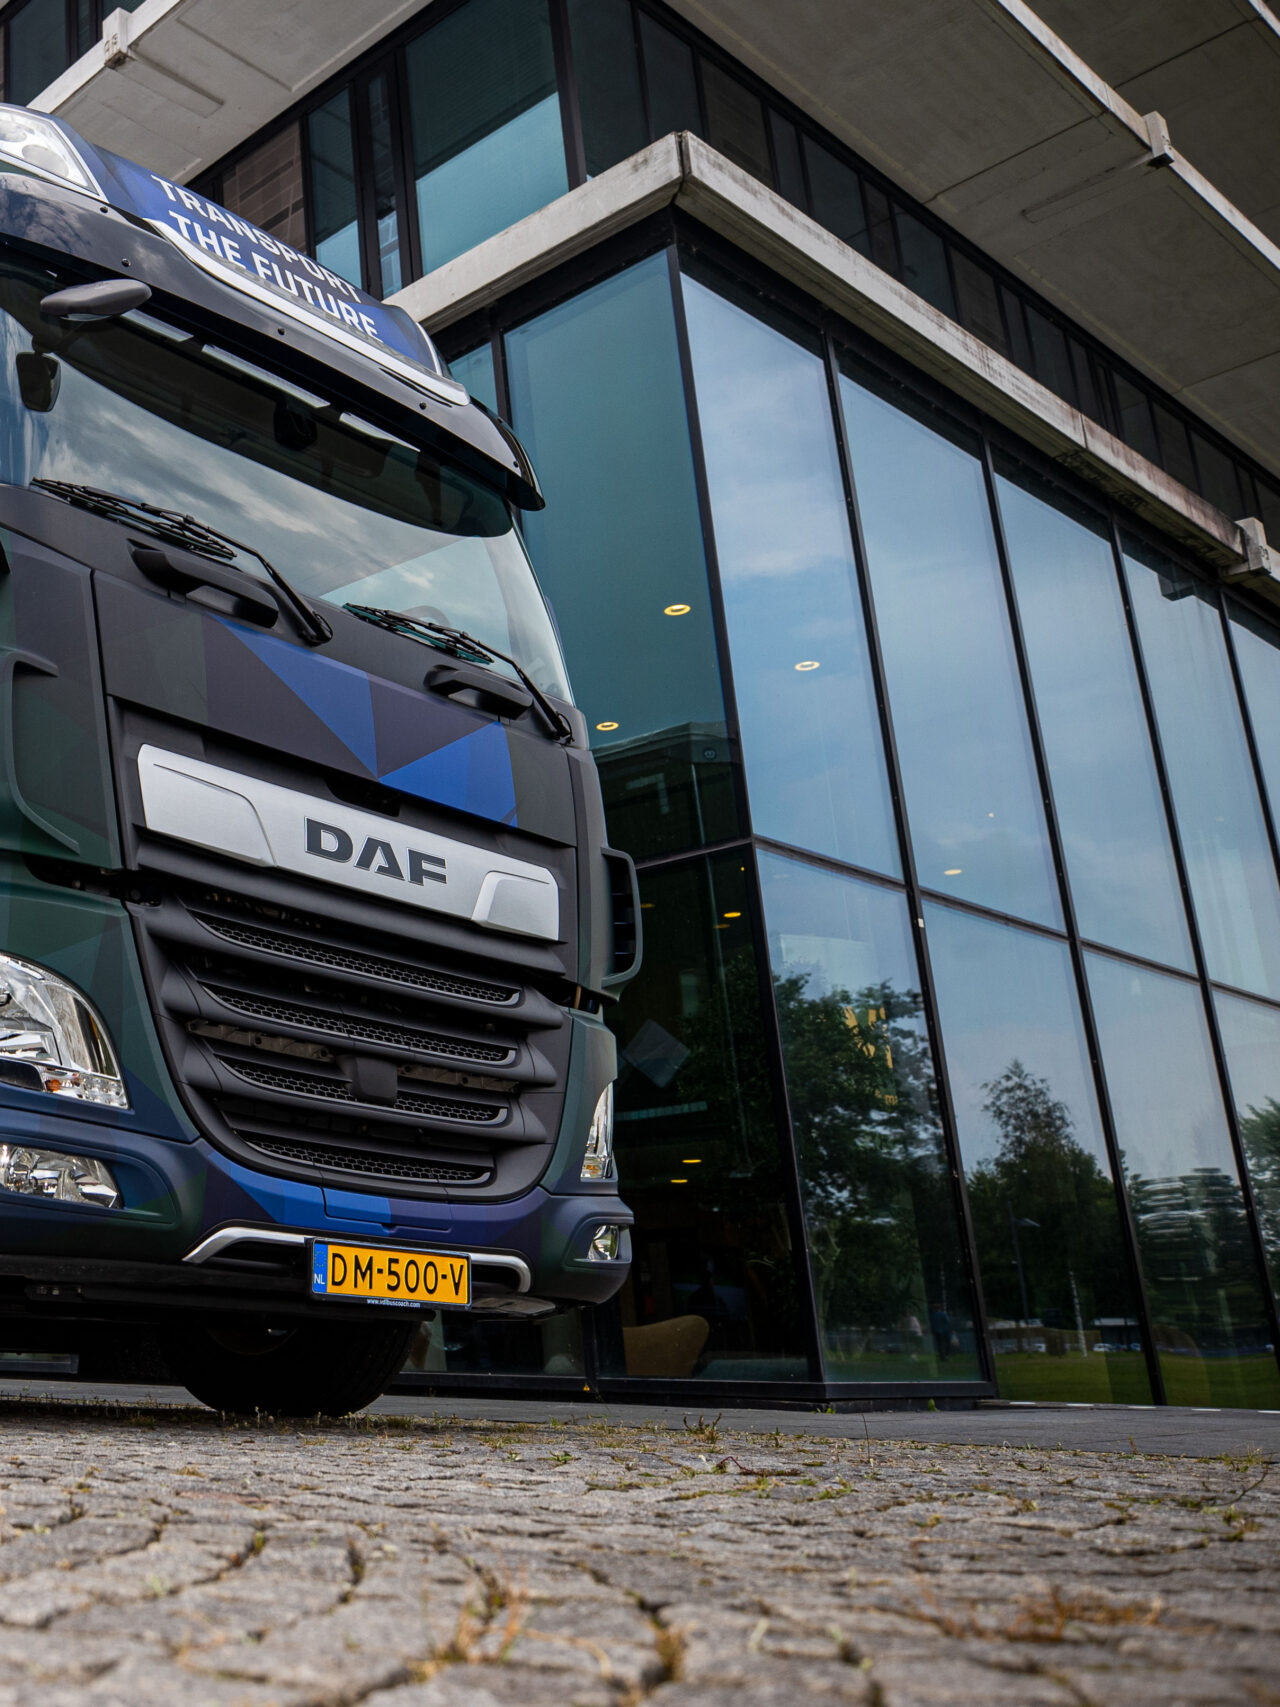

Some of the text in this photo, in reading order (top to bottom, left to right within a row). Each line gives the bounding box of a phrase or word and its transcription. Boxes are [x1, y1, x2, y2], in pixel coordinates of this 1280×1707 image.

[151, 174, 362, 304] TRANSPORT
[168, 209, 384, 343] THE FUTURE
[303, 815, 448, 887] DAF
[313, 1252, 464, 1296] NL DM-500-V
